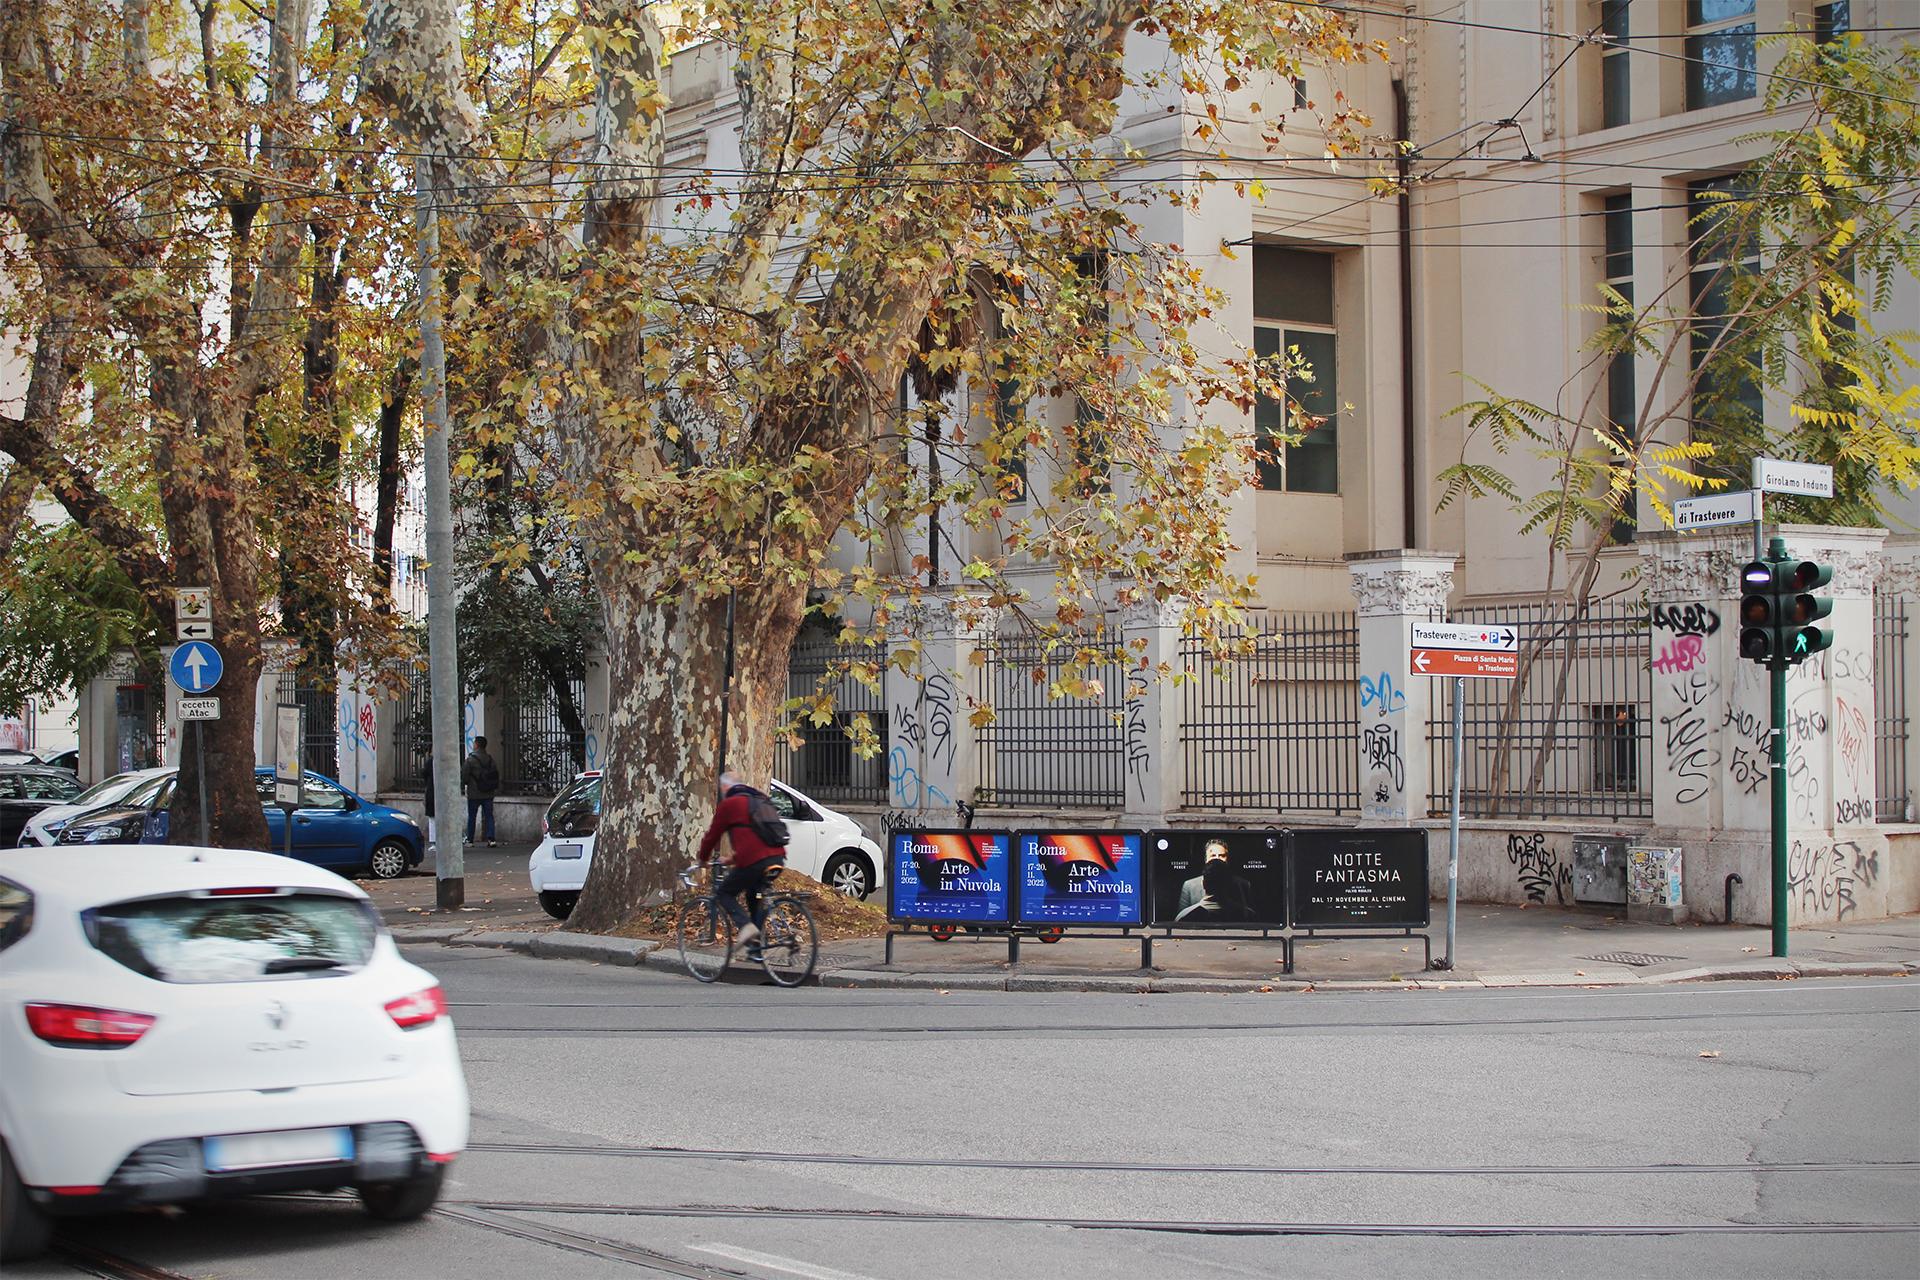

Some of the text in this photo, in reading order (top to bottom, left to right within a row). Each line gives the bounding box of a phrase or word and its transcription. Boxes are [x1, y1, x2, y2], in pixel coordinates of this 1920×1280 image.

[1766, 474, 1828, 491] Girolamo Induno
[1679, 510, 1735, 524] di Trastevere
[1415, 629, 1457, 640] Trastevere
[1454, 654, 1514, 664] Piazza di Santa Maria
[1485, 664, 1514, 673] Trastevere
[189, 709, 209, 717] Atac
[902, 840, 939, 854] Roma
[1027, 842, 1068, 856] Roma
[901, 861, 921, 869] 17-20.
[1333, 853, 1382, 866] NOTTE
[940, 861, 970, 875] Arte
[1027, 863, 1047, 871] 17-20.
[1068, 863, 1100, 877] Arte
[901, 877, 918, 885] 2022
[1315, 869, 1401, 883] FANTASMA
[940, 877, 1001, 892] in Nuvola
[1026, 879, 1044, 887] 2022
[1068, 879, 1134, 894] in Nuvola
[1382, 895, 1406, 903] CINEMA
